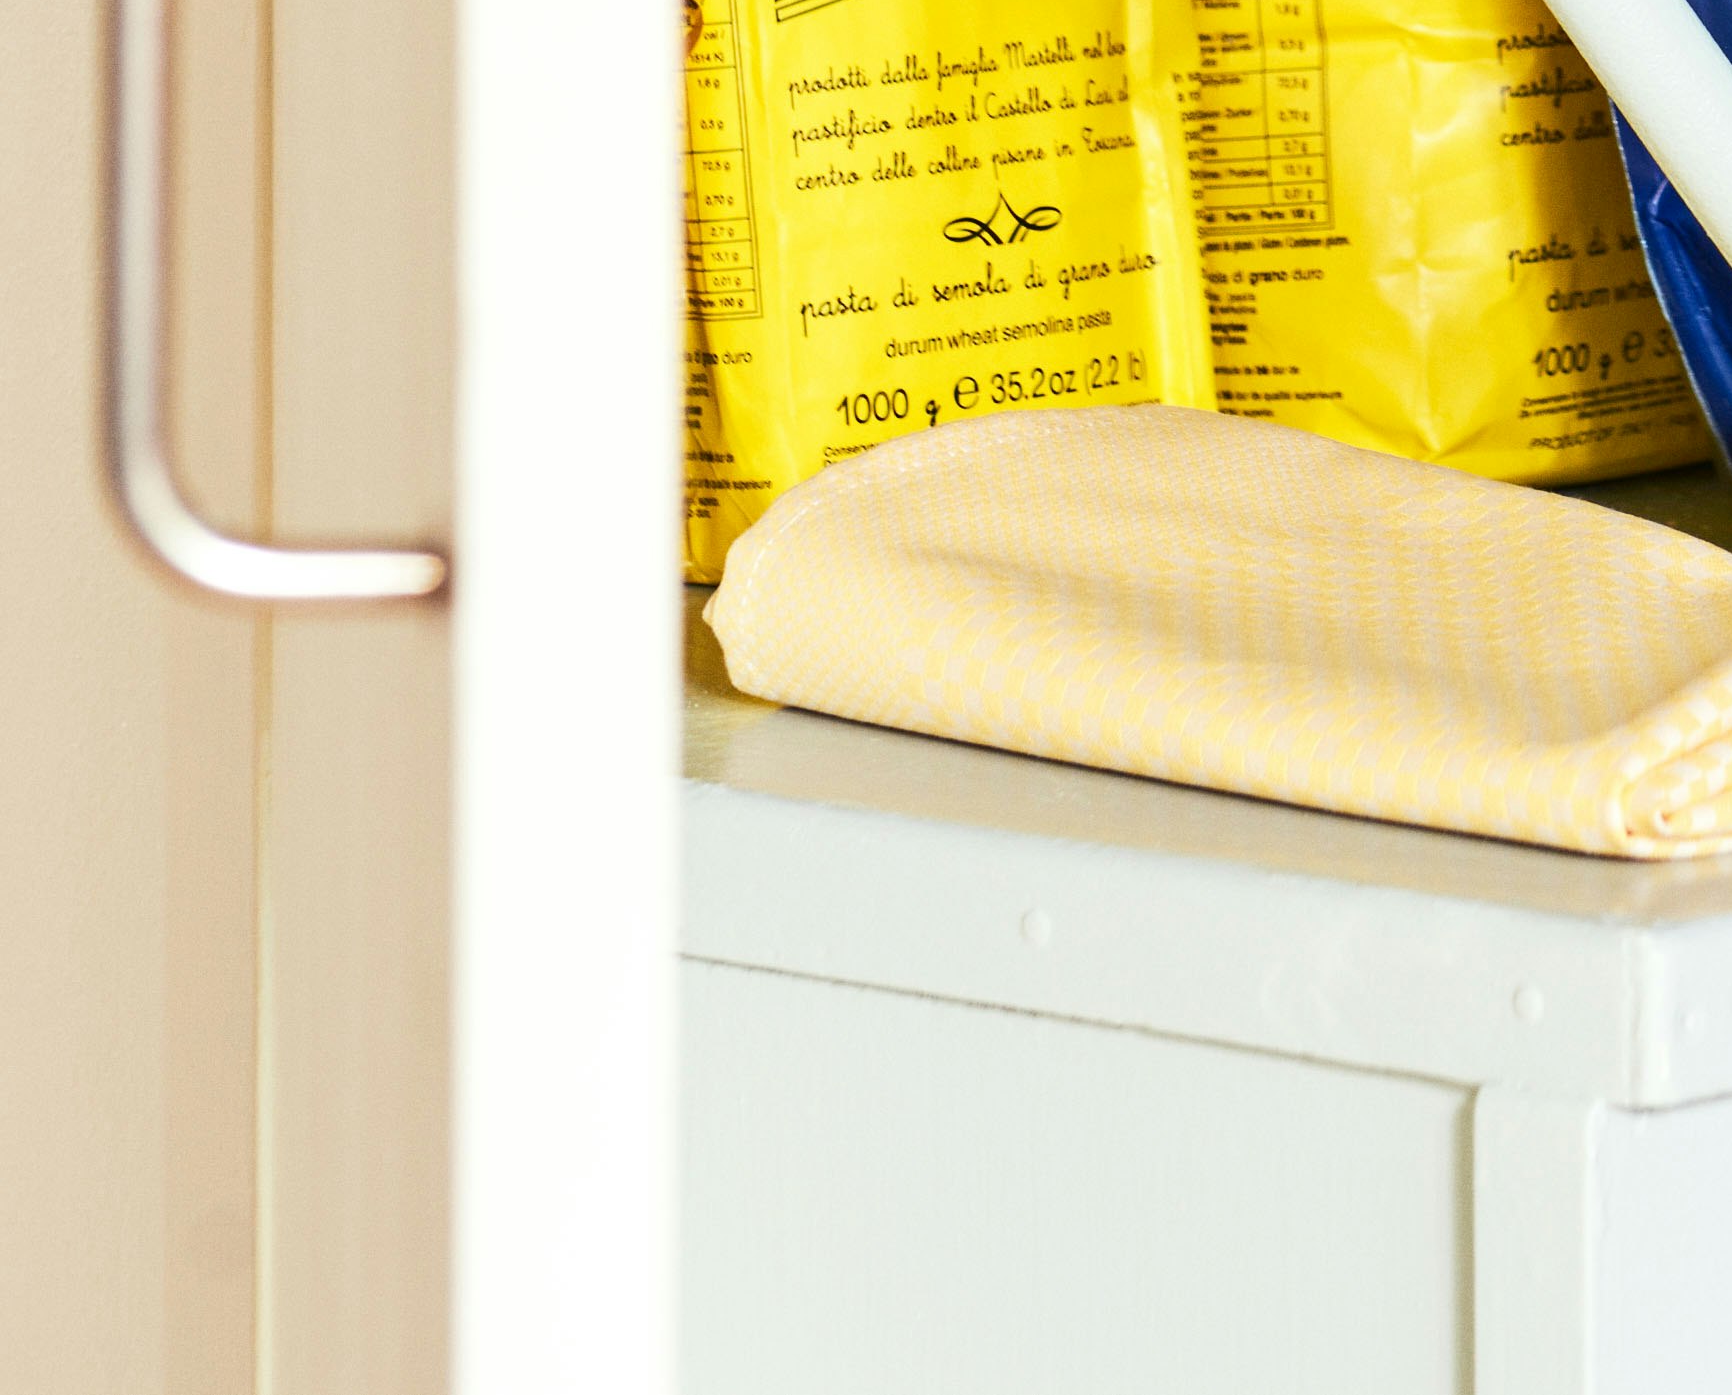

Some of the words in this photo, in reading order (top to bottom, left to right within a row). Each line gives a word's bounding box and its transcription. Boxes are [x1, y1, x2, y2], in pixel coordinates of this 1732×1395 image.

[789, 66, 870, 111] prodotti
[881, 55, 929, 85] dalla
[937, 46, 998, 92] famiglia
[1004, 36, 1076, 70] Martelli
[792, 109, 892, 158] pastificio
[905, 105, 958, 130] dentro
[966, 94, 980, 122] il
[985, 87, 1052, 120] Castello
[1060, 86, 1077, 110] di
[795, 163, 861, 191] centro
[872, 151, 916, 182] delle
[927, 144, 981, 175] colline
[992, 147, 1046, 180] pisane
[1055, 140, 1074, 158] in
[800, 286, 878, 338] pasta
[892, 277, 918, 309] di
[934, 261, 1011, 302] semola
[1024, 260, 1047, 291] di
[1058, 263, 1110, 300] grano
[885, 335, 943, 359] durum
[949, 329, 998, 350] wheat
[1002, 317, 1076, 343] semolina
[1078, 309, 1113, 335] pasta
[1533, 343, 1590, 378] 1000
[836, 389, 909, 426] 1000
[925, 399, 941, 427] g
[824, 442, 881, 458] Conserv
